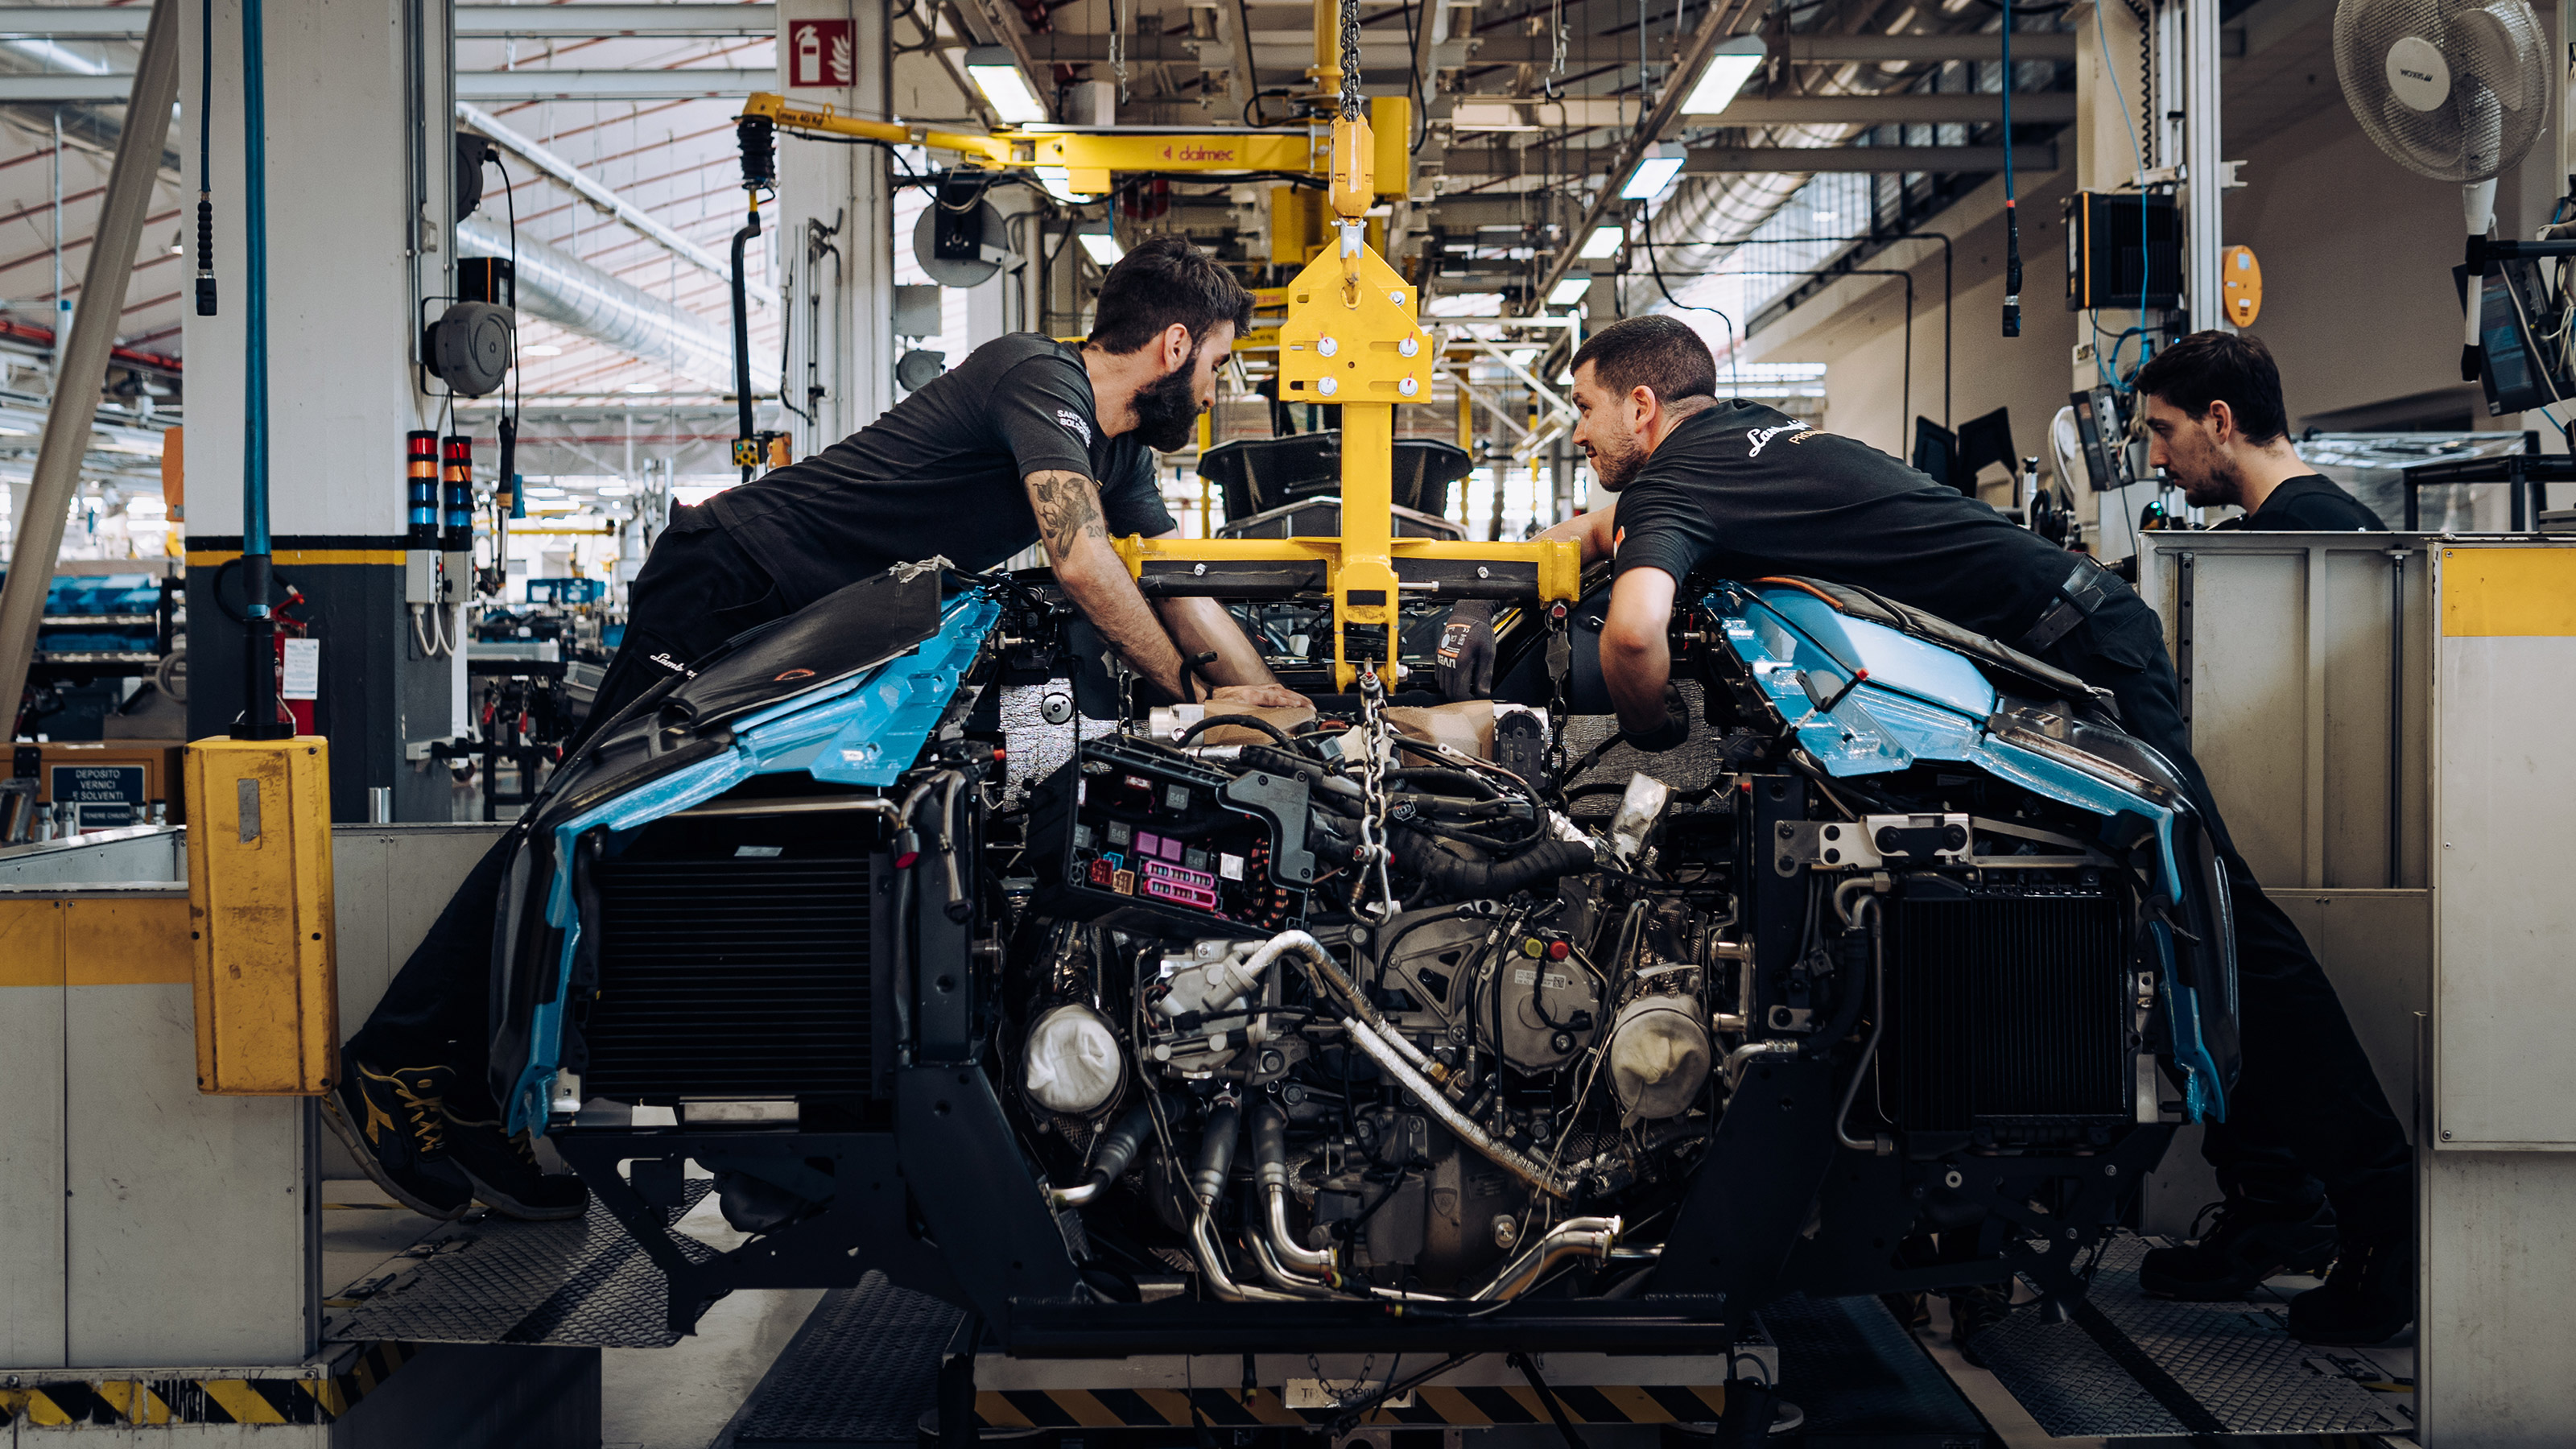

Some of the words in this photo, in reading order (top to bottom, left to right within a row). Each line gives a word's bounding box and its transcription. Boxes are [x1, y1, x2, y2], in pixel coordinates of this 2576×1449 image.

[1179, 145, 1233, 161] dalmec
[76, 770, 121, 778] DEPOSITO
[80, 781, 116, 790] VERNICI
[72, 791, 79, 800] E
[80, 791, 124, 800] SOLVENTI
[1111, 828, 1127, 840] 645
